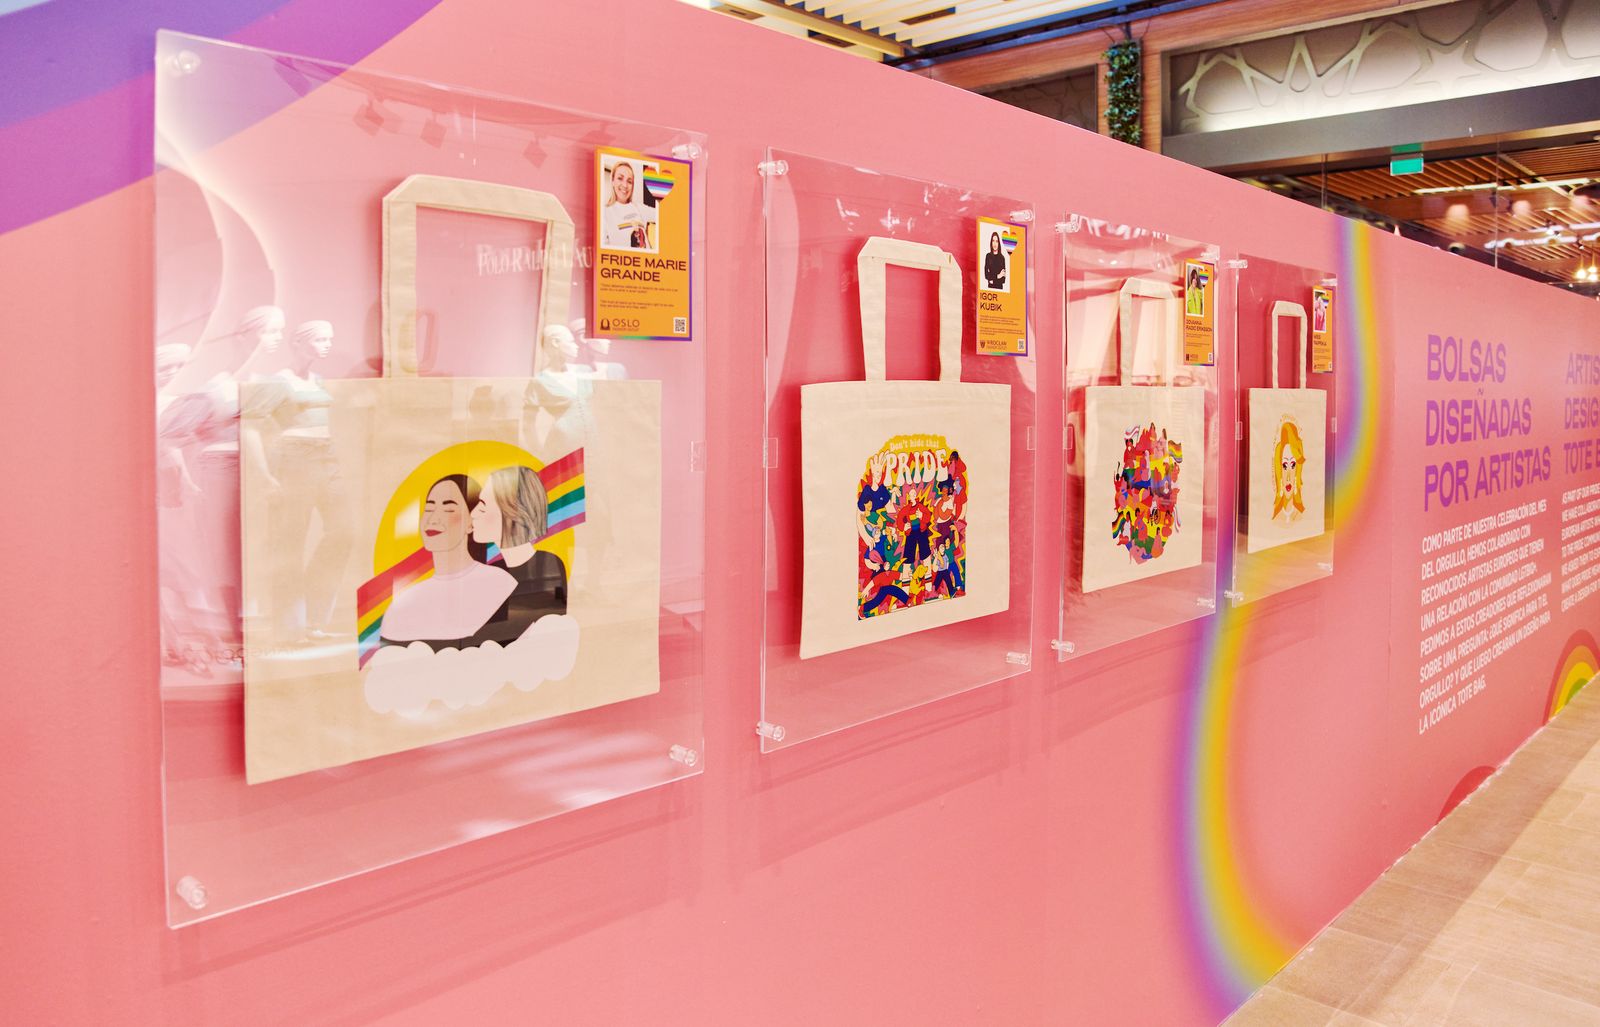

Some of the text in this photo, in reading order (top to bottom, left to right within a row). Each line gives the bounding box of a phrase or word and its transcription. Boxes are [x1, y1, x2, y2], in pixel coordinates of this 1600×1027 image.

[600, 253, 687, 271] FRIDE MARIE
[600, 267, 661, 282] GRANDE
[612, 318, 640, 328] OSLO
[980, 292, 998, 302] IGOR
[980, 302, 1003, 311] KUBIK
[1427, 334, 1507, 383] BOLSAS
[1425, 387, 1532, 446] DISEÑADAS
[883, 448, 949, 487] PRIDE
[1424, 446, 1551, 512] POR ARTISTAS
[1563, 440, 1593, 474] TOTE
[1421, 523, 1531, 580] DEL ORGULLO, HEMOS COLABORADO CON
[1422, 533, 1443, 554] COMO
[1443, 526, 1463, 547] PARTE
[1463, 523, 1472, 540] DE
[1472, 515, 1497, 537] NUESTRA
[1497, 502, 1529, 528] CELEBRACIÓN
[1421, 572, 1467, 606] RECONOCIDOS
[1467, 560, 1493, 585] ARTISTAS
[1493, 548, 1519, 573] EUROPEOS
[1518, 544, 1529, 560] QUE
[1421, 610, 1436, 632] UNA
[1436, 593, 1468, 624] RELACIÓN
[1468, 588, 1481, 607] CON
[1481, 584, 1489, 601] LA
[1489, 569, 1518, 597] COMUNIDAD
[1420, 628, 1450, 658] PEDIMOS
[1450, 624, 1456, 641] A
[1456, 613, 1475, 637] ESTOS
[1475, 596, 1507, 626] CREADORES
[1506, 590, 1517, 608] QUE
[1420, 655, 1443, 683] SOBRE
[1443, 647, 1457, 668] UNA
[1503, 606, 1526, 631] SIGNIFICA
[1525, 599, 1538, 617] PARA
[1420, 672, 1454, 709] ORGULLO?
[1454, 668, 1460, 685] Y
[1460, 660, 1473, 681] QUE
[1473, 648, 1492, 673] LUEGO
[1492, 632, 1516, 659] CREARAN
[1515, 628, 1523, 644] UN
[1419, 674, 1487, 735] LA ICÓNICA TOTE BAG.
